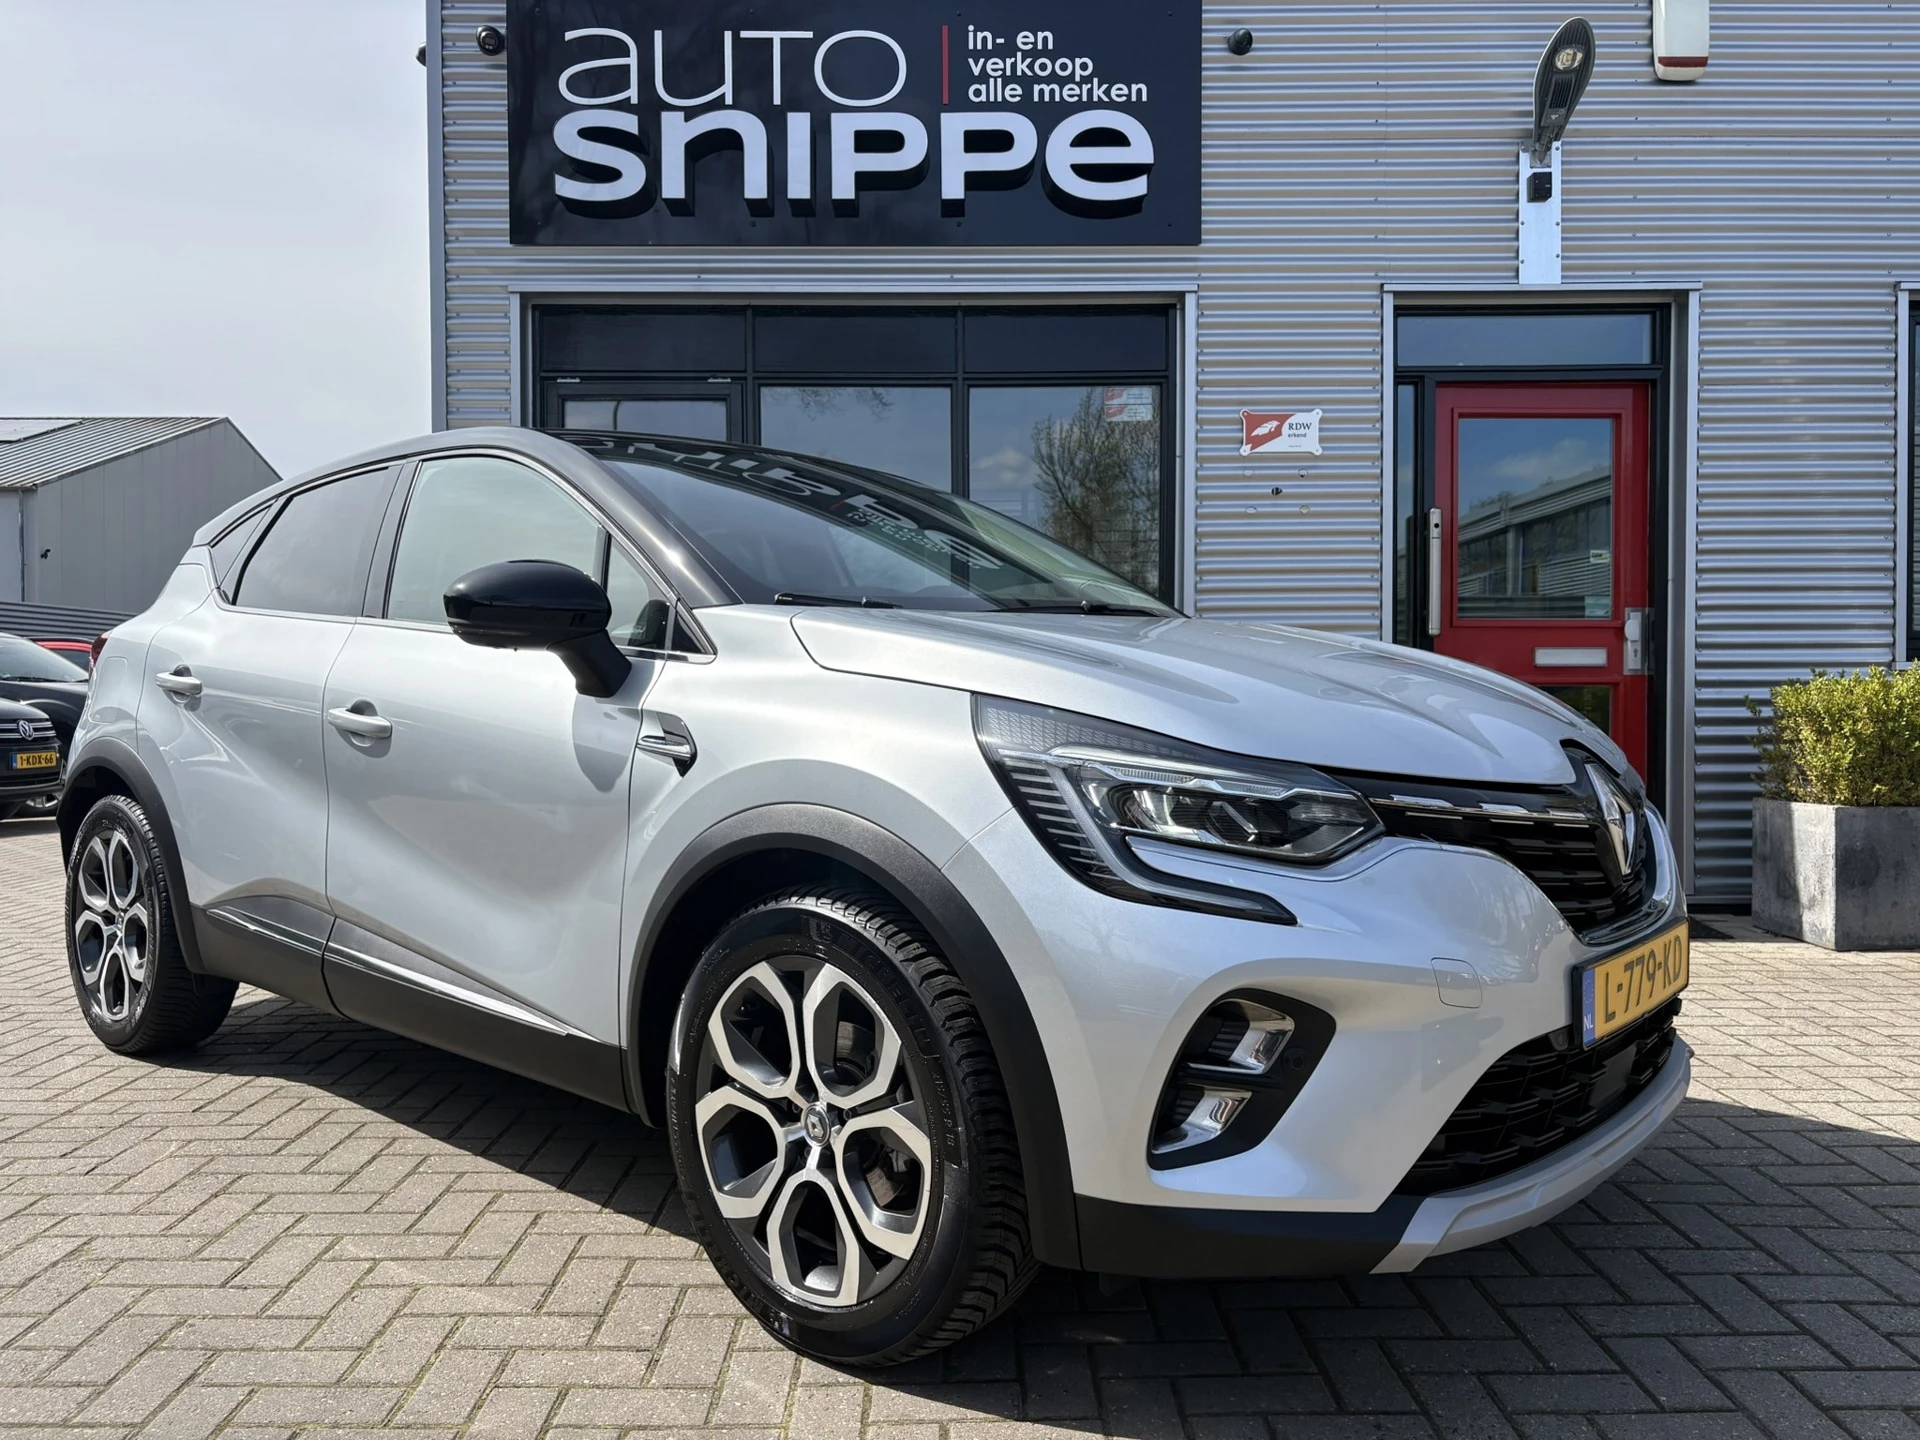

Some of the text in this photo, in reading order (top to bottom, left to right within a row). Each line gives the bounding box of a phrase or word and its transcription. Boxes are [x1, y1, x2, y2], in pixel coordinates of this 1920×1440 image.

[967, 24, 1054, 50] in- en
[967, 51, 1094, 82] verkoop
[967, 77, 1148, 102] alle merken
[1288, 422, 1312, 431] RDW
[20, 754, 54, 767] 1-KDX-66
[1604, 934, 1683, 1024] L-779-KD
[1583, 1013, 1594, 1031] NL
